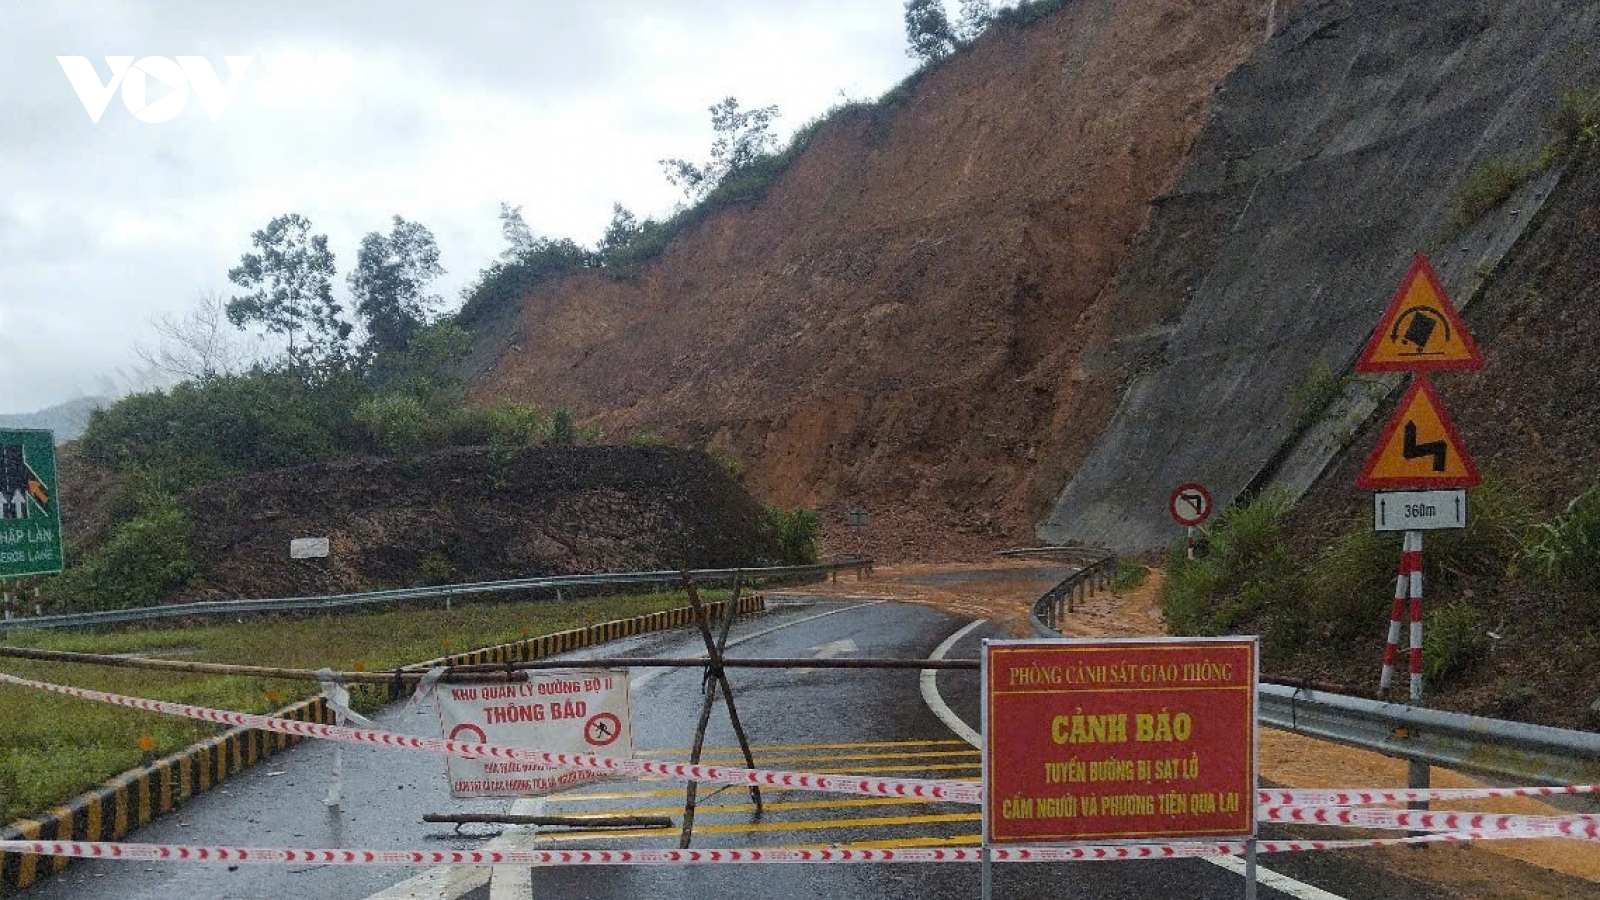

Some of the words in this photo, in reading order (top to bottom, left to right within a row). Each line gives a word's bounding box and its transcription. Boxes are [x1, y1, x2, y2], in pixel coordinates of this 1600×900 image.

[1404, 503, 1436, 518] 360m
[1009, 661, 1062, 685] PHÒNG
[1065, 660, 1107, 684] CẢNH
[1110, 659, 1138, 684] SÁT
[1141, 663, 1178, 683] GIAO
[1182, 658, 1232, 681] THÔNG
[452, 688, 477, 701] KHU
[538, 679, 581, 695] ĐƯỜNG
[584, 677, 601, 694] BỘ
[604, 677, 612, 690] II
[484, 702, 545, 725] THÔNG
[550, 698, 587, 720] BÁO
[1051, 706, 1128, 745] CẢNH
[1044, 755, 1087, 784] TUYẾN
[1089, 756, 1134, 782] ĐƯỜNG
[1137, 760, 1151, 784] BỊ
[1155, 758, 1178, 784] SẠT
[1182, 751, 1199, 779] LỞ
[1002, 791, 1033, 819] CẤM
[1036, 792, 1077, 818] NGƯỜI
[1080, 792, 1098, 817] VÀ
[1101, 793, 1154, 816] PHƯƠNG
[1158, 789, 1187, 819] TIỆN
[1190, 792, 1215, 816] QUA
[1219, 792, 1239, 818] LẠI
